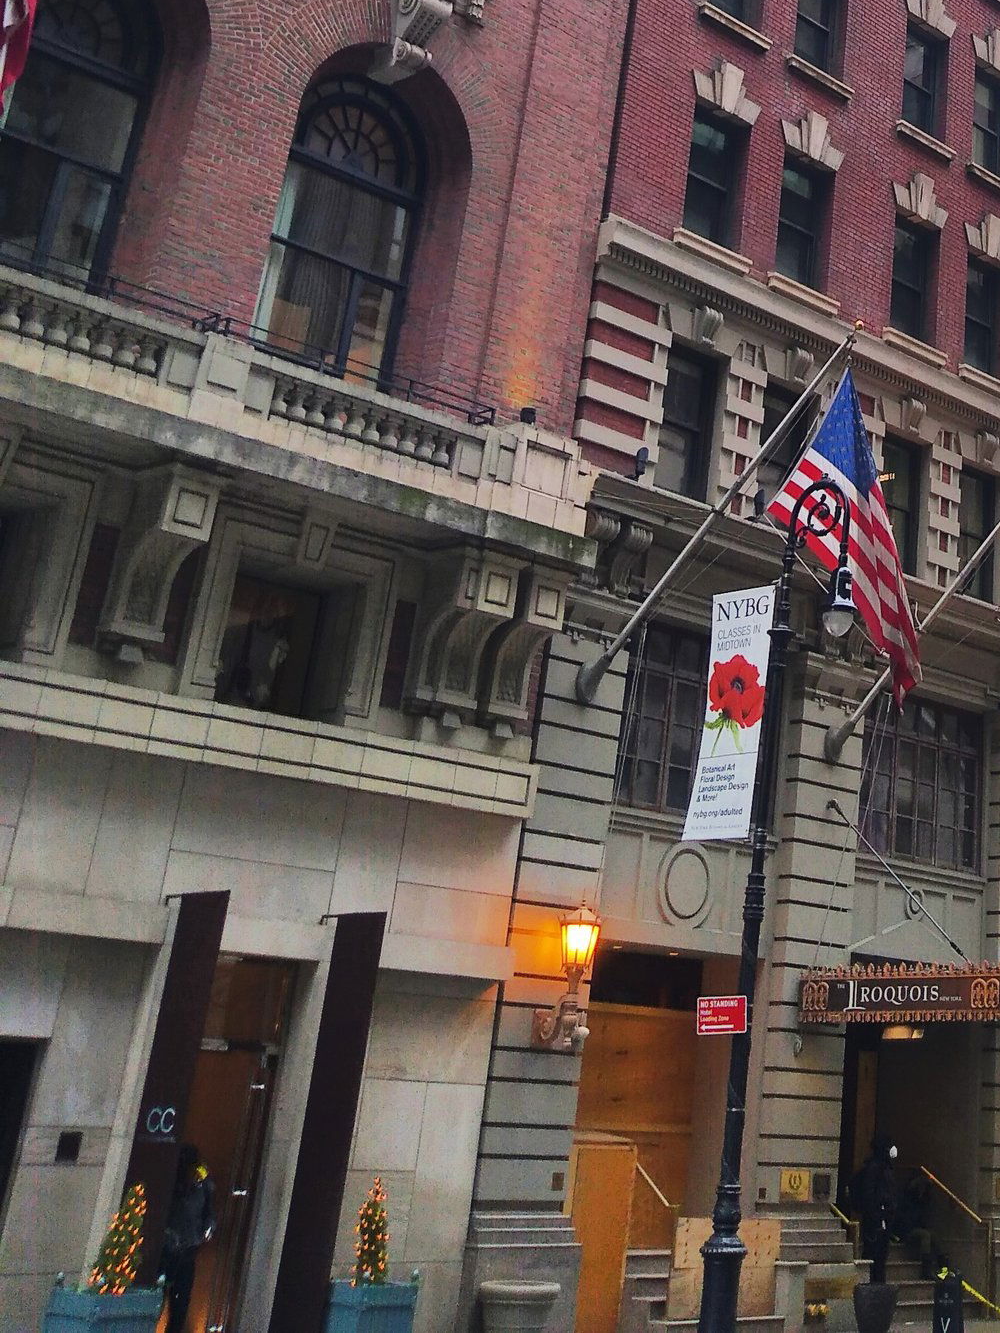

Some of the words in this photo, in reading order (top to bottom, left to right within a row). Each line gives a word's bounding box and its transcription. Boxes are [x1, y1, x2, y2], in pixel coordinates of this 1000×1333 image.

[716, 595, 770, 622] NYBG
[718, 625, 751, 639] CLASSES
[753, 624, 761, 634] IN
[717, 638, 751, 651] MIDTOWN
[702, 764, 726, 774] Botanical
[727, 763, 736, 771] Art
[700, 775, 715, 784] Floral
[716, 774, 735, 782] Design
[698, 785, 727, 793] Landscape
[728, 782, 749, 791] Design
[693, 808, 743, 819] nybg.org/adulted
[843, 980, 940, 1013] IROQUOIS
[700, 1000, 709, 1008] NO
[710, 999, 738, 1007] STANDING
